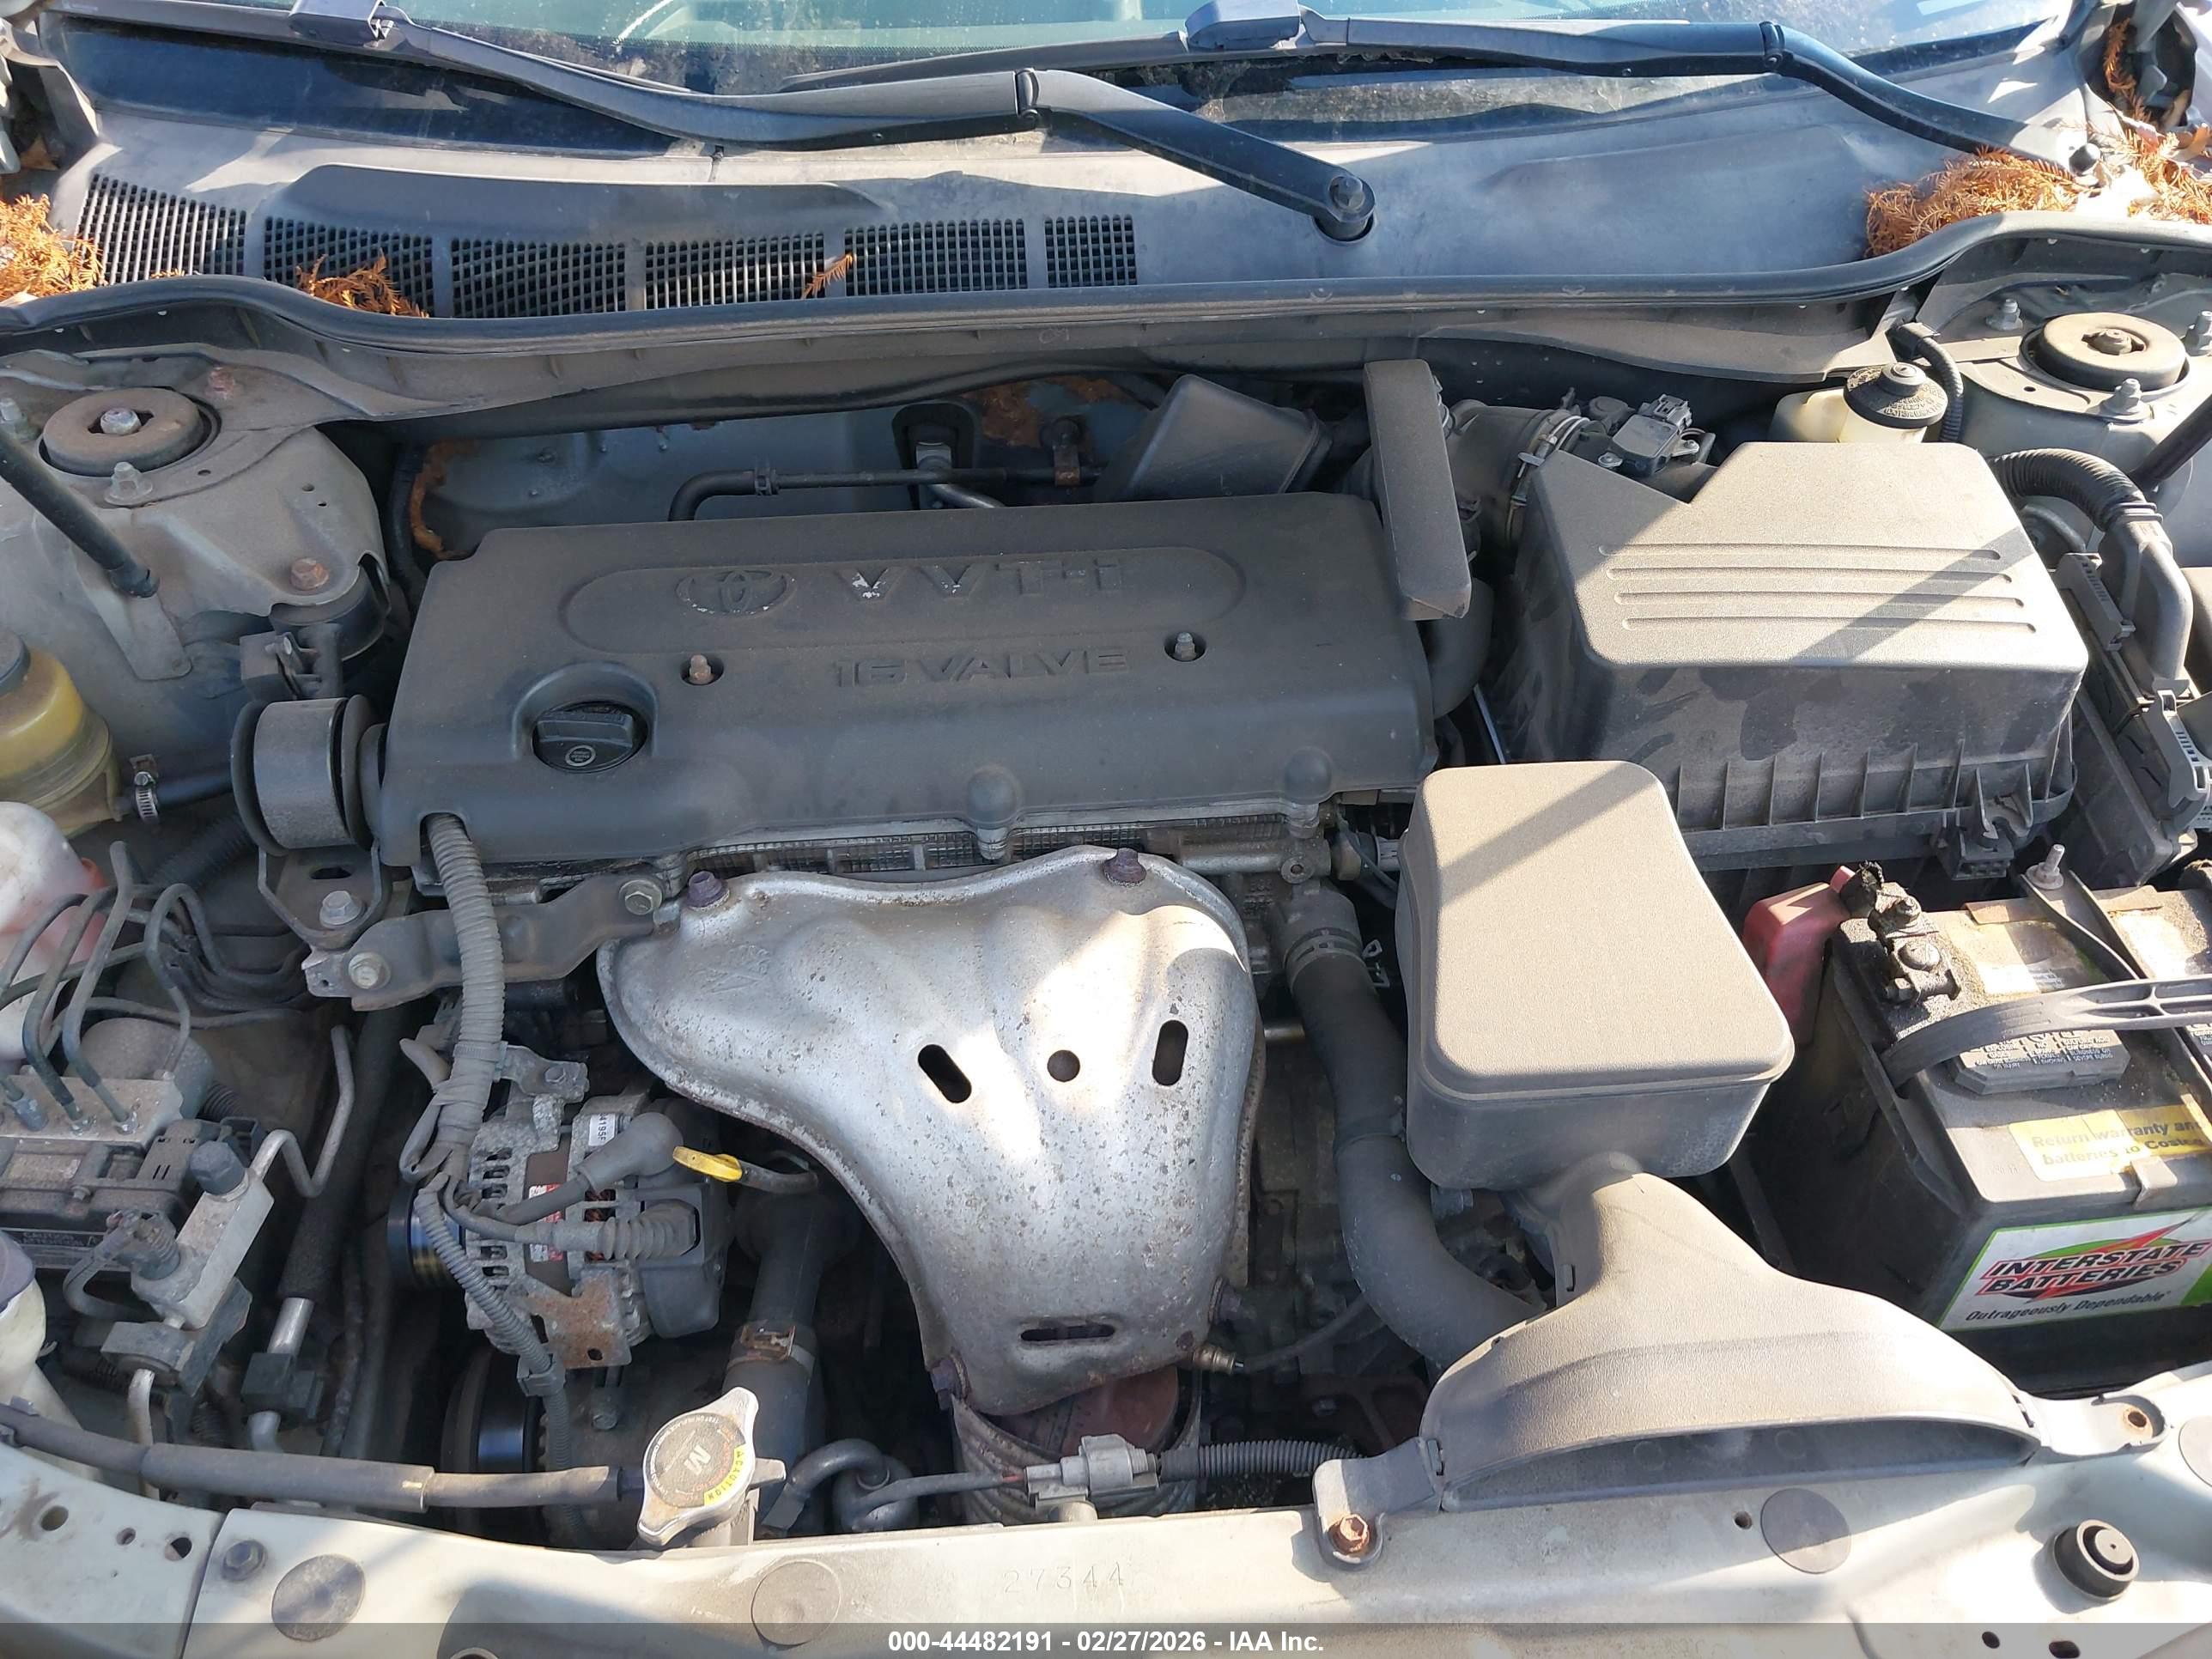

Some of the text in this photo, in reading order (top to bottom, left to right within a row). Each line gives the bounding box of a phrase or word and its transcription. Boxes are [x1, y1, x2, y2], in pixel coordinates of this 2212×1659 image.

[2032, 1132, 2089, 1148] Return
[2095, 1121, 2168, 1141] warranty
[2042, 1148, 2118, 1166] batteries
[1989, 1241, 2211, 1276] INTERSTATE
[1985, 1260, 2183, 1292] BATTERIES
[1965, 1303, 2072, 1322] Outrageously
[707, 1460, 744, 1501] CAUTION
[1003, 1559, 1127, 1596] 27344
